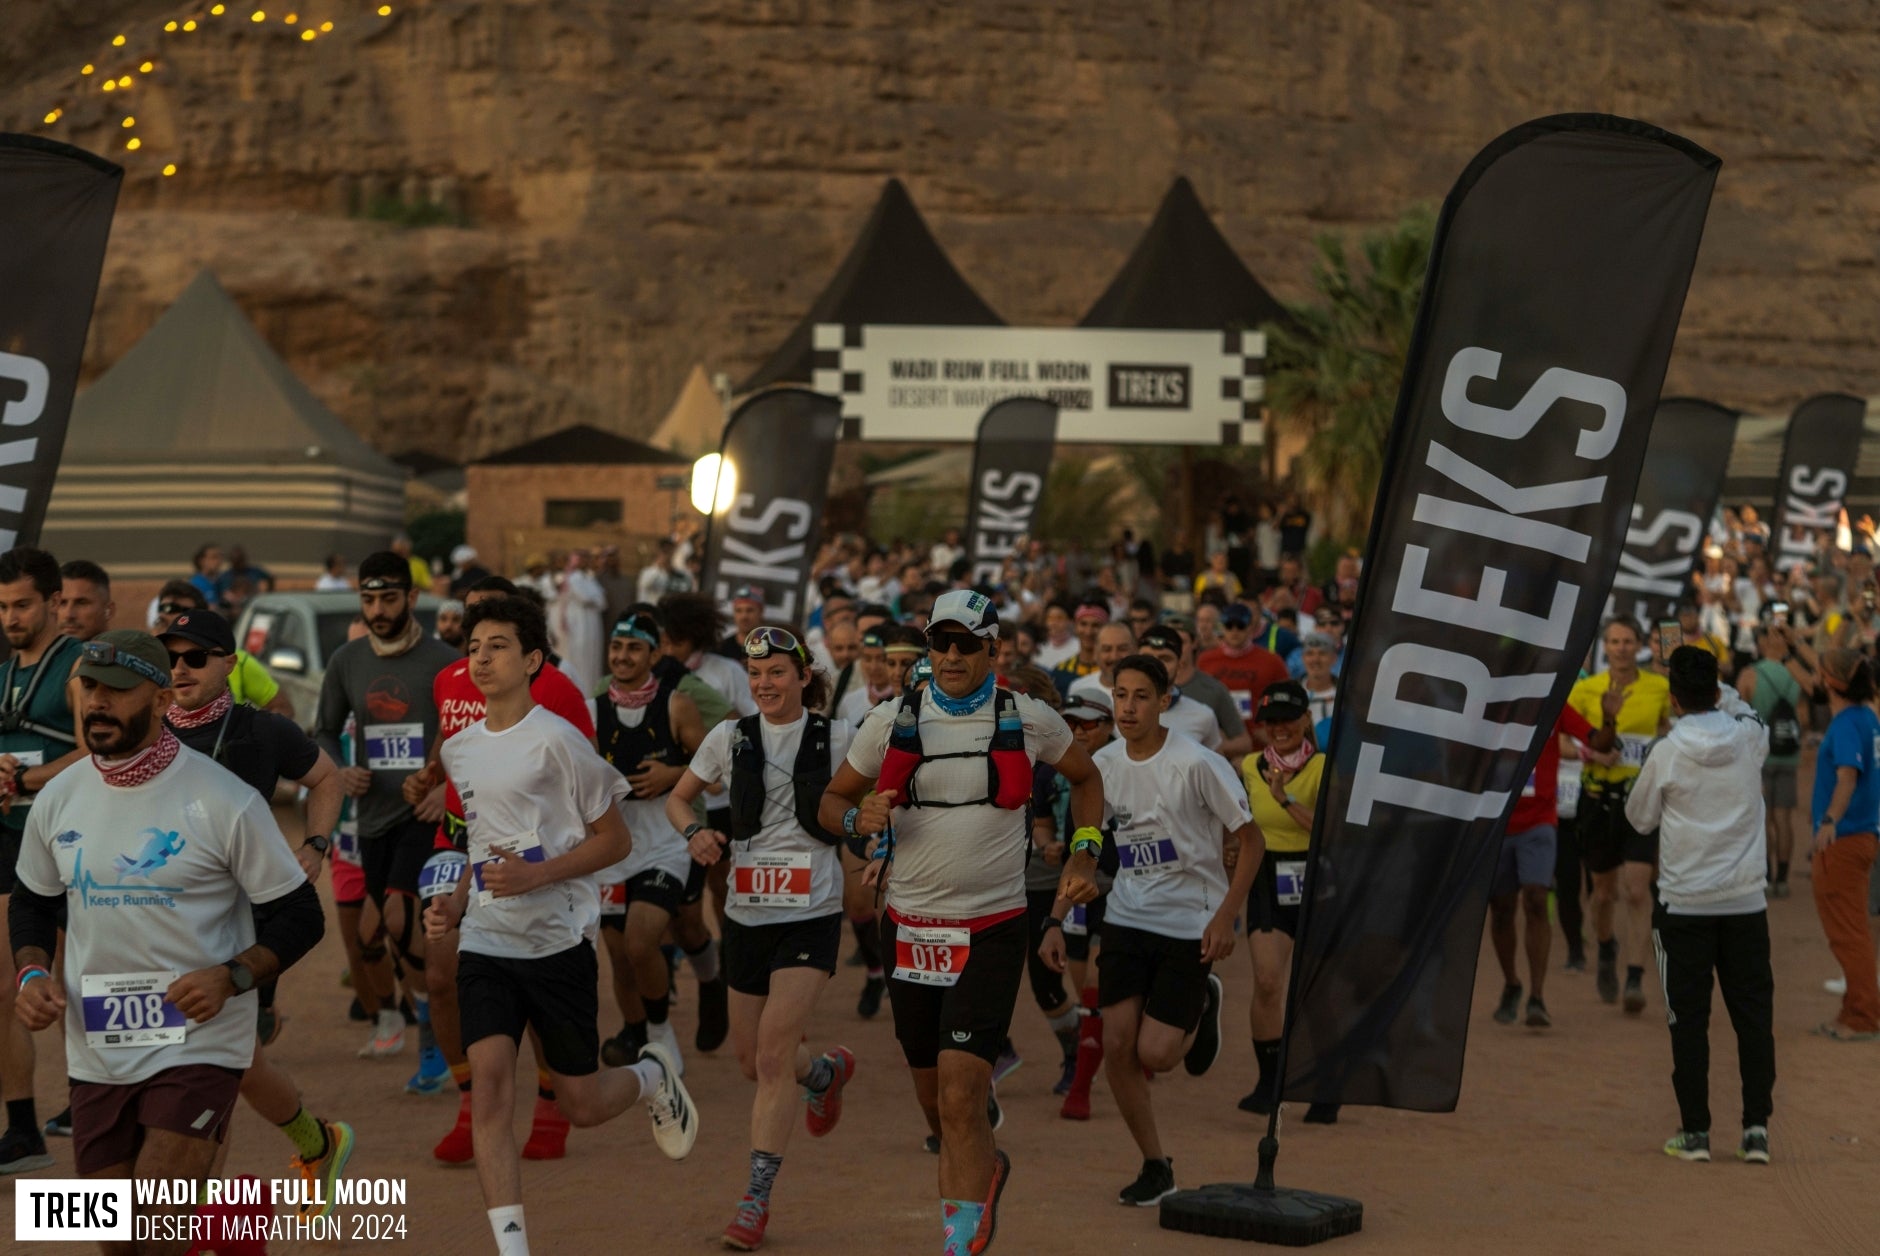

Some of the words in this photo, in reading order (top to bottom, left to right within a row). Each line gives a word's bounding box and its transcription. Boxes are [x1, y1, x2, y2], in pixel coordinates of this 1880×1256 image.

[890, 358, 938, 381] WADI
[942, 359, 984, 381] RUM
[988, 359, 1030, 382] FULL
[1037, 361, 1091, 383] MOON
[888, 384, 948, 408] DESERT
[1114, 370, 1185, 403] TREKS
[1776, 464, 1847, 573] EKS
[1345, 346, 1627, 827] TREKS
[381, 737, 410, 759] 113
[1130, 841, 1161, 868] 207
[433, 863, 461, 884] 191
[752, 868, 792, 894] 012
[89, 895, 119, 908] Keep
[123, 894, 176, 908] Running
[911, 944, 952, 972] 013
[103, 994, 165, 1031] 208
